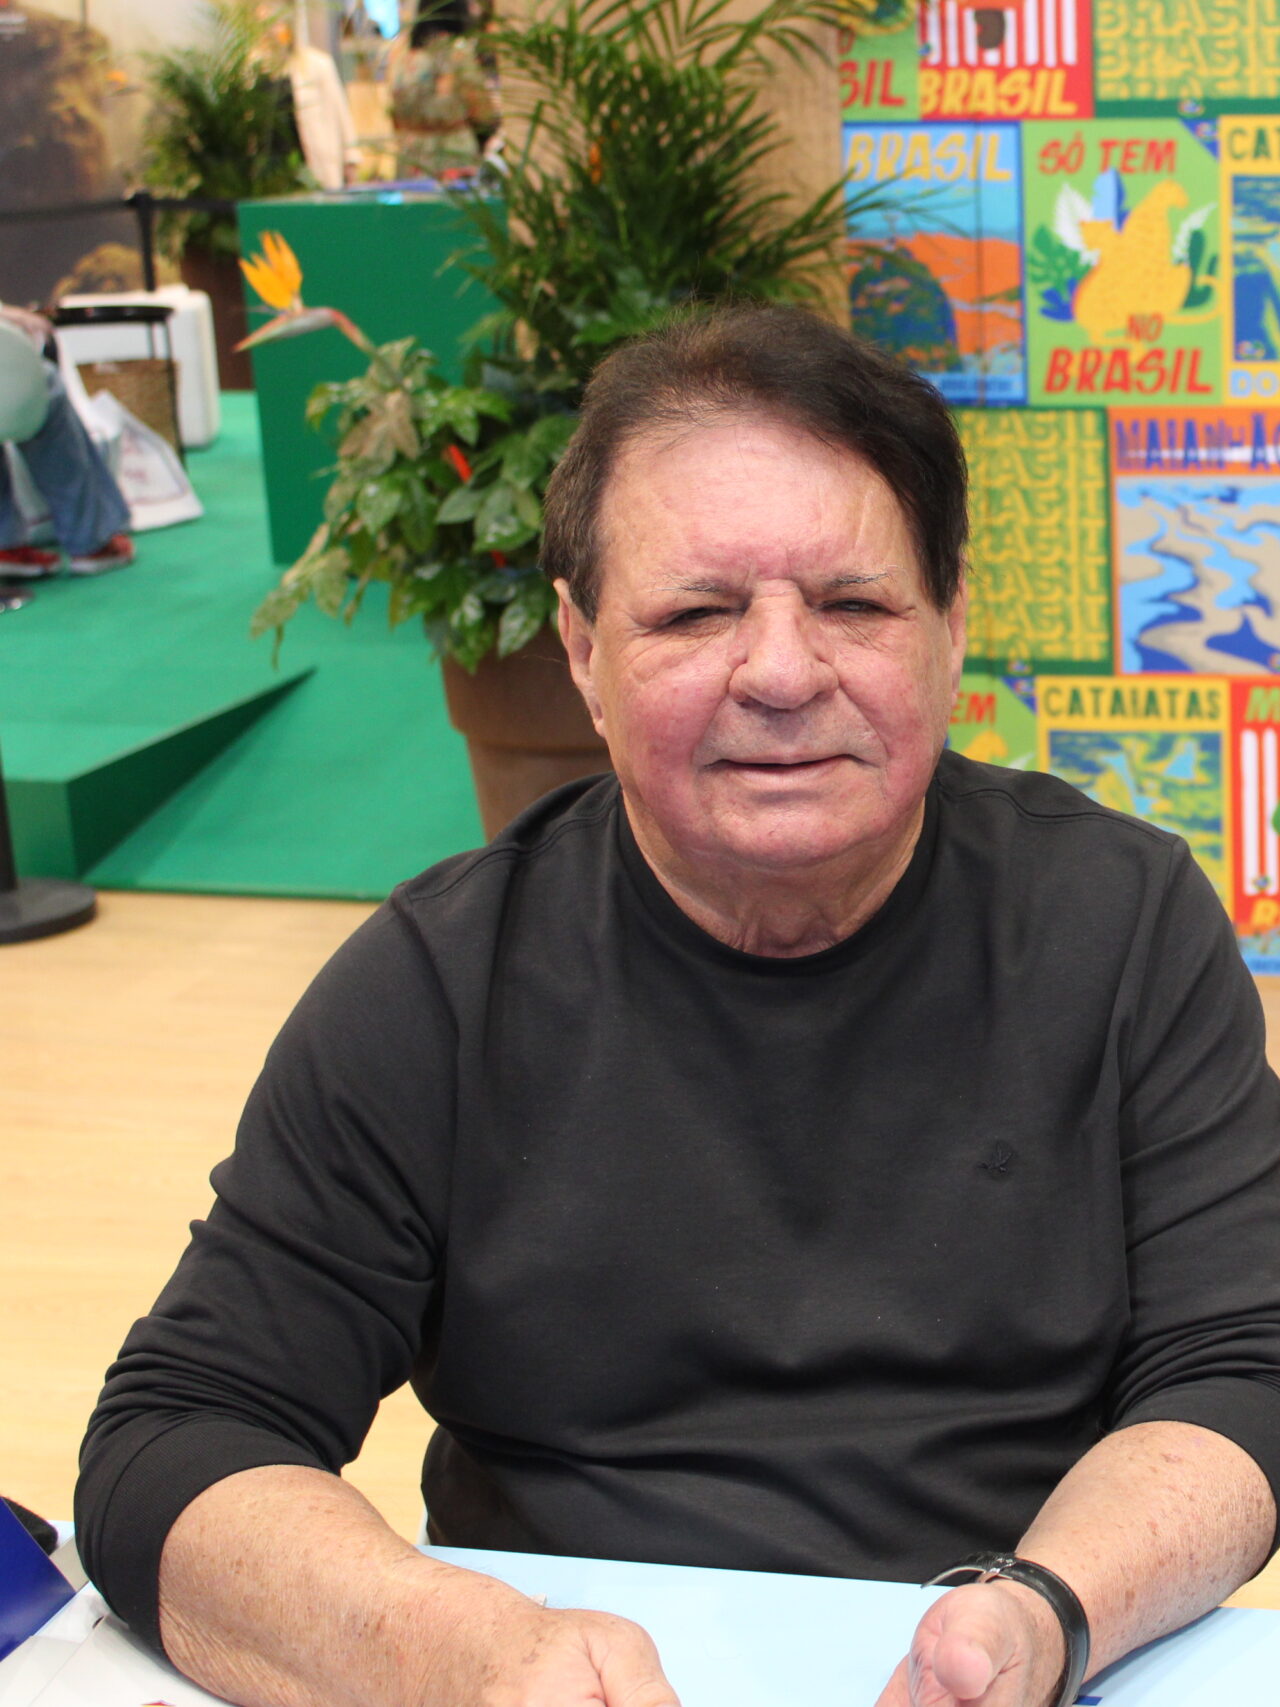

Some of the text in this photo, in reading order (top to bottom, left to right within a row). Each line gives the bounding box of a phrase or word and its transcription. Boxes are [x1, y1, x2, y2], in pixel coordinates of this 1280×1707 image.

[839, 59, 906, 108] SIL
[919, 67, 1079, 115] BRASIL
[847, 131, 1013, 182] BRASIL
[1038, 130, 1178, 175] SÓ TEM
[1043, 347, 1214, 395] BRASIL
[949, 691, 997, 727] EM
